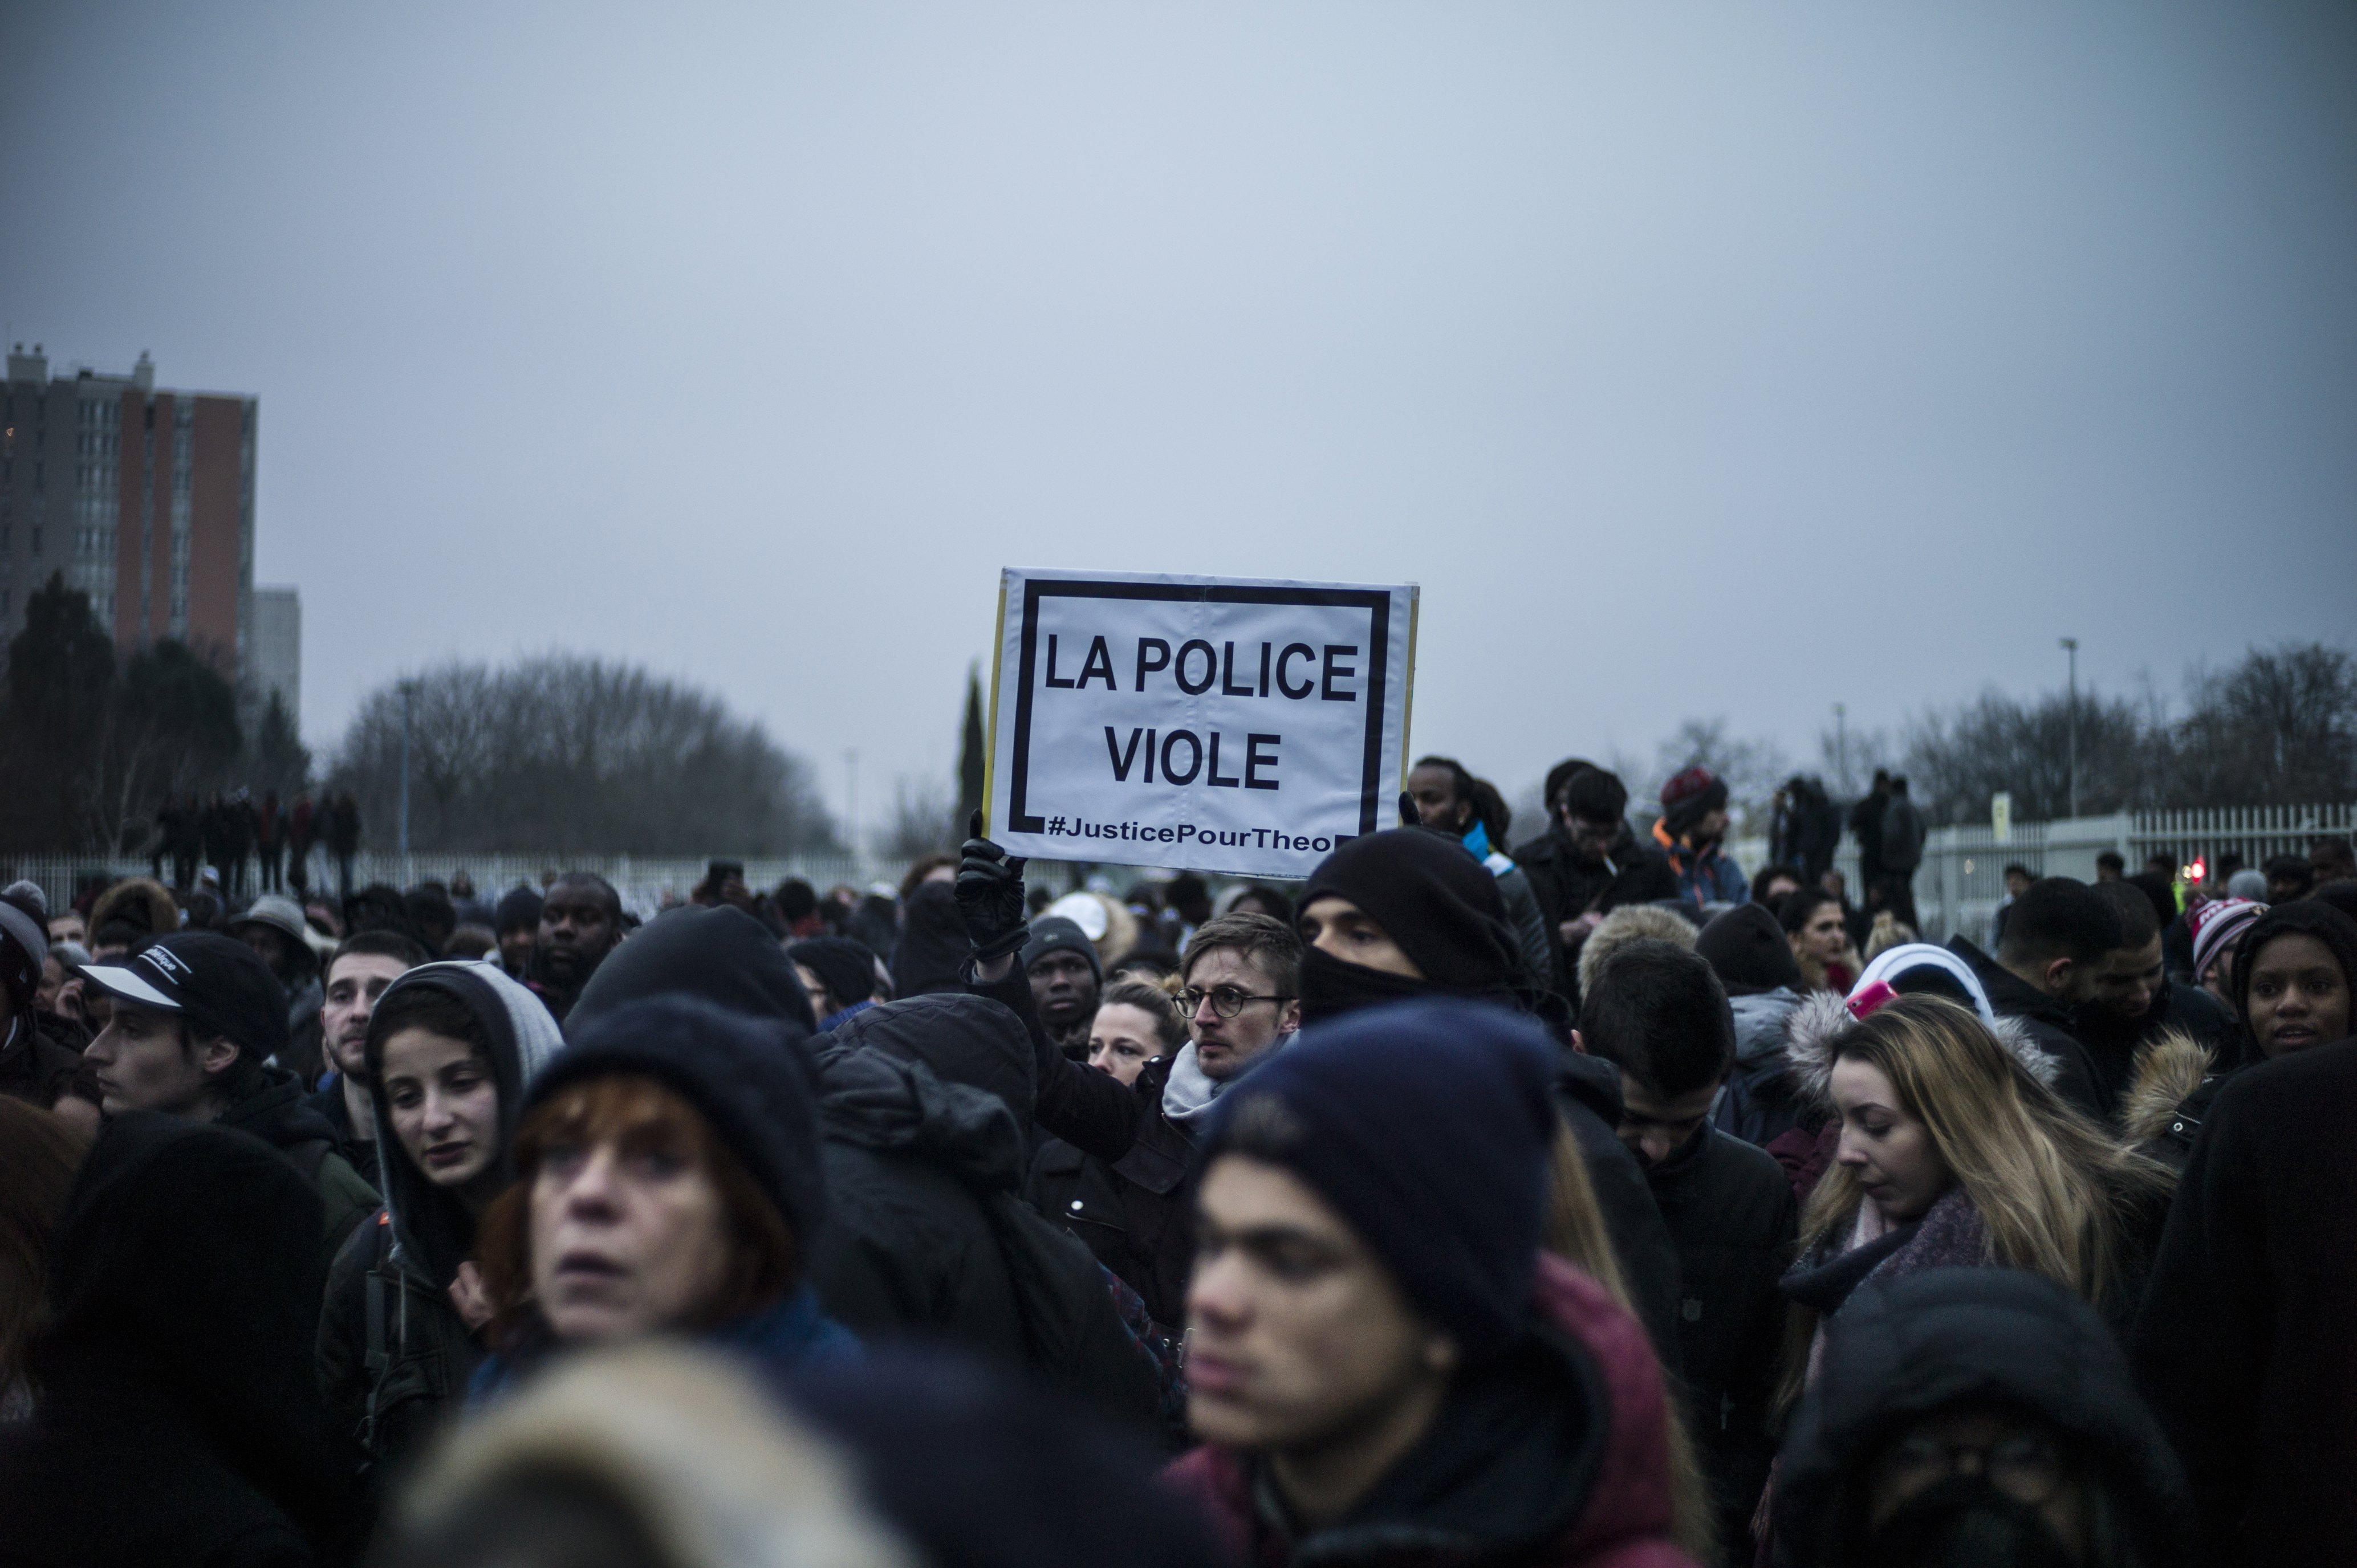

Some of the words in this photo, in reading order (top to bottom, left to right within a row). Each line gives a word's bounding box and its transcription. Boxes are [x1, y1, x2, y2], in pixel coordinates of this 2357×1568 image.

[1045, 634, 1117, 691] LA
[1135, 637, 1359, 702] POLICE
[1104, 726, 1281, 791] VIOLE
[1048, 816, 1331, 852] #JusticePourTheo
